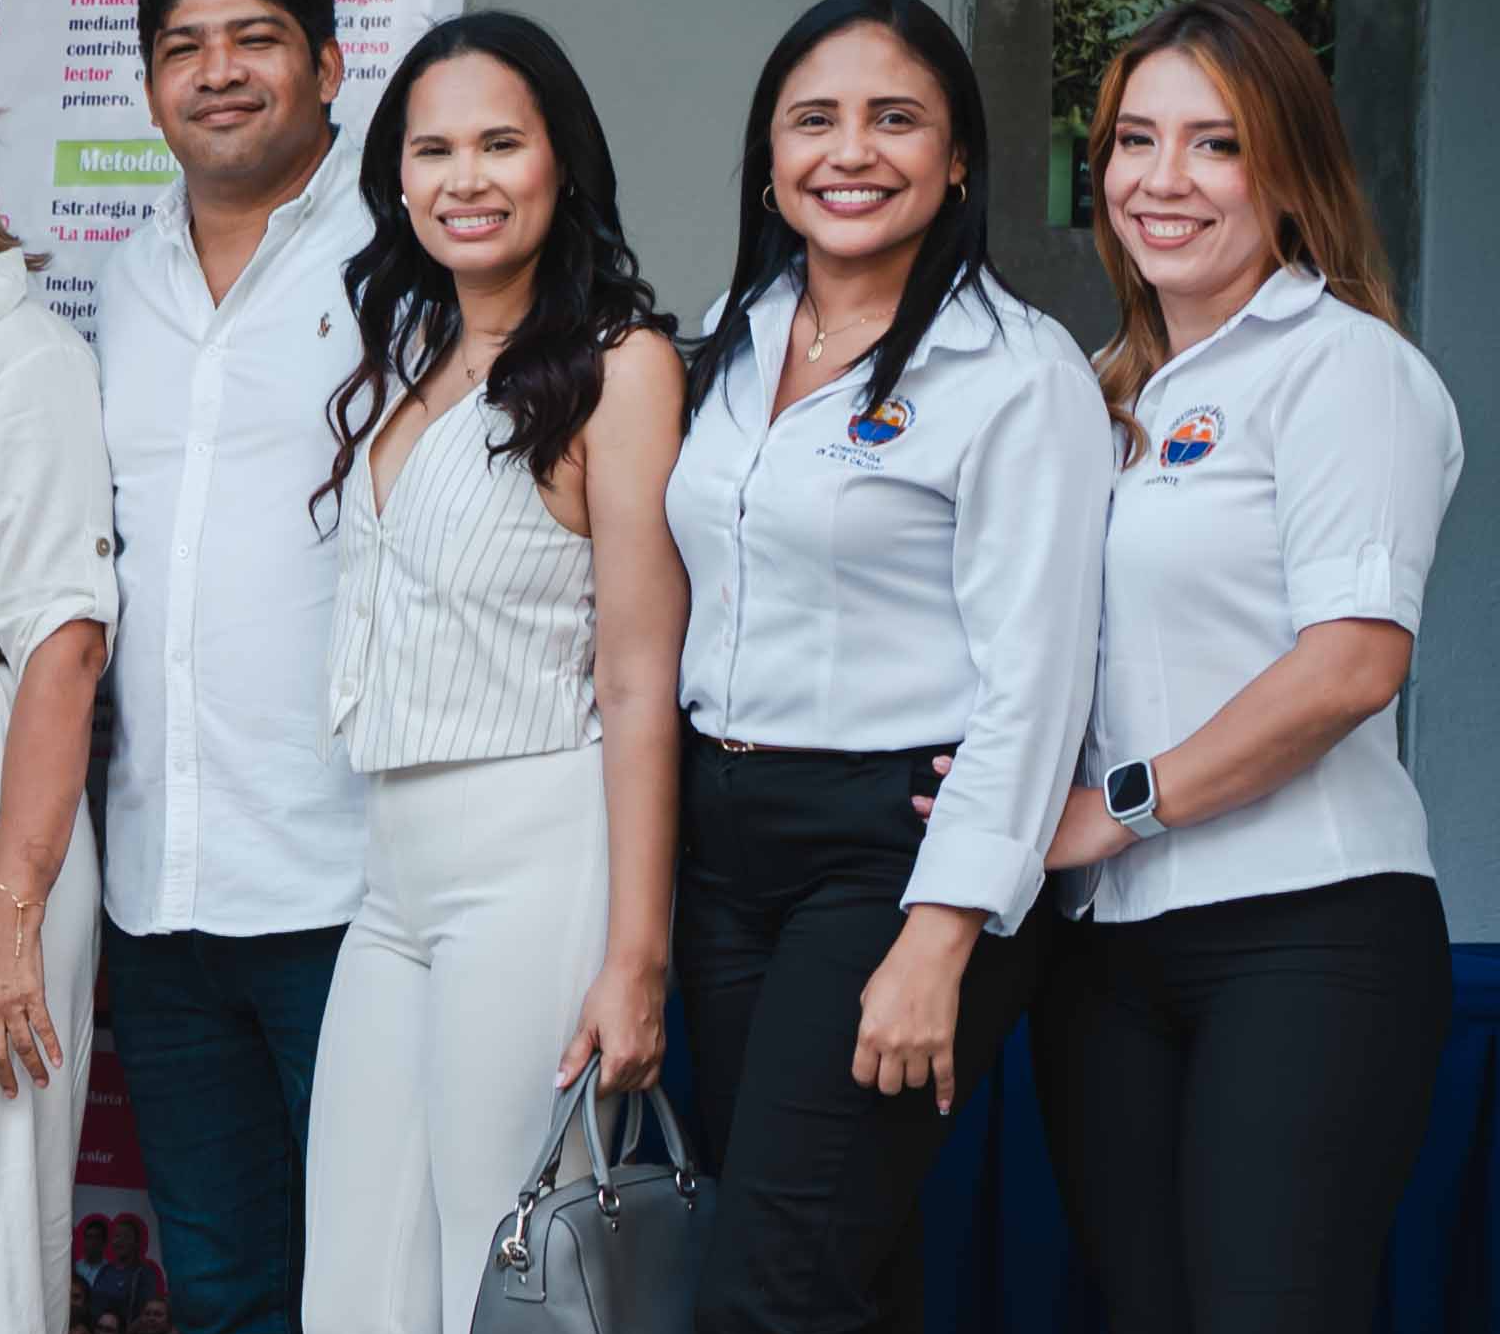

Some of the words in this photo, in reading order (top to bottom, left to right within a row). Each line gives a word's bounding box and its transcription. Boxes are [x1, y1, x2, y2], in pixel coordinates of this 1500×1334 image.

[360, 17, 391, 32] que
[64, 66, 113, 82] lector
[61, 90, 134, 110] primero.
[51, 198, 137, 220] Estrategia
